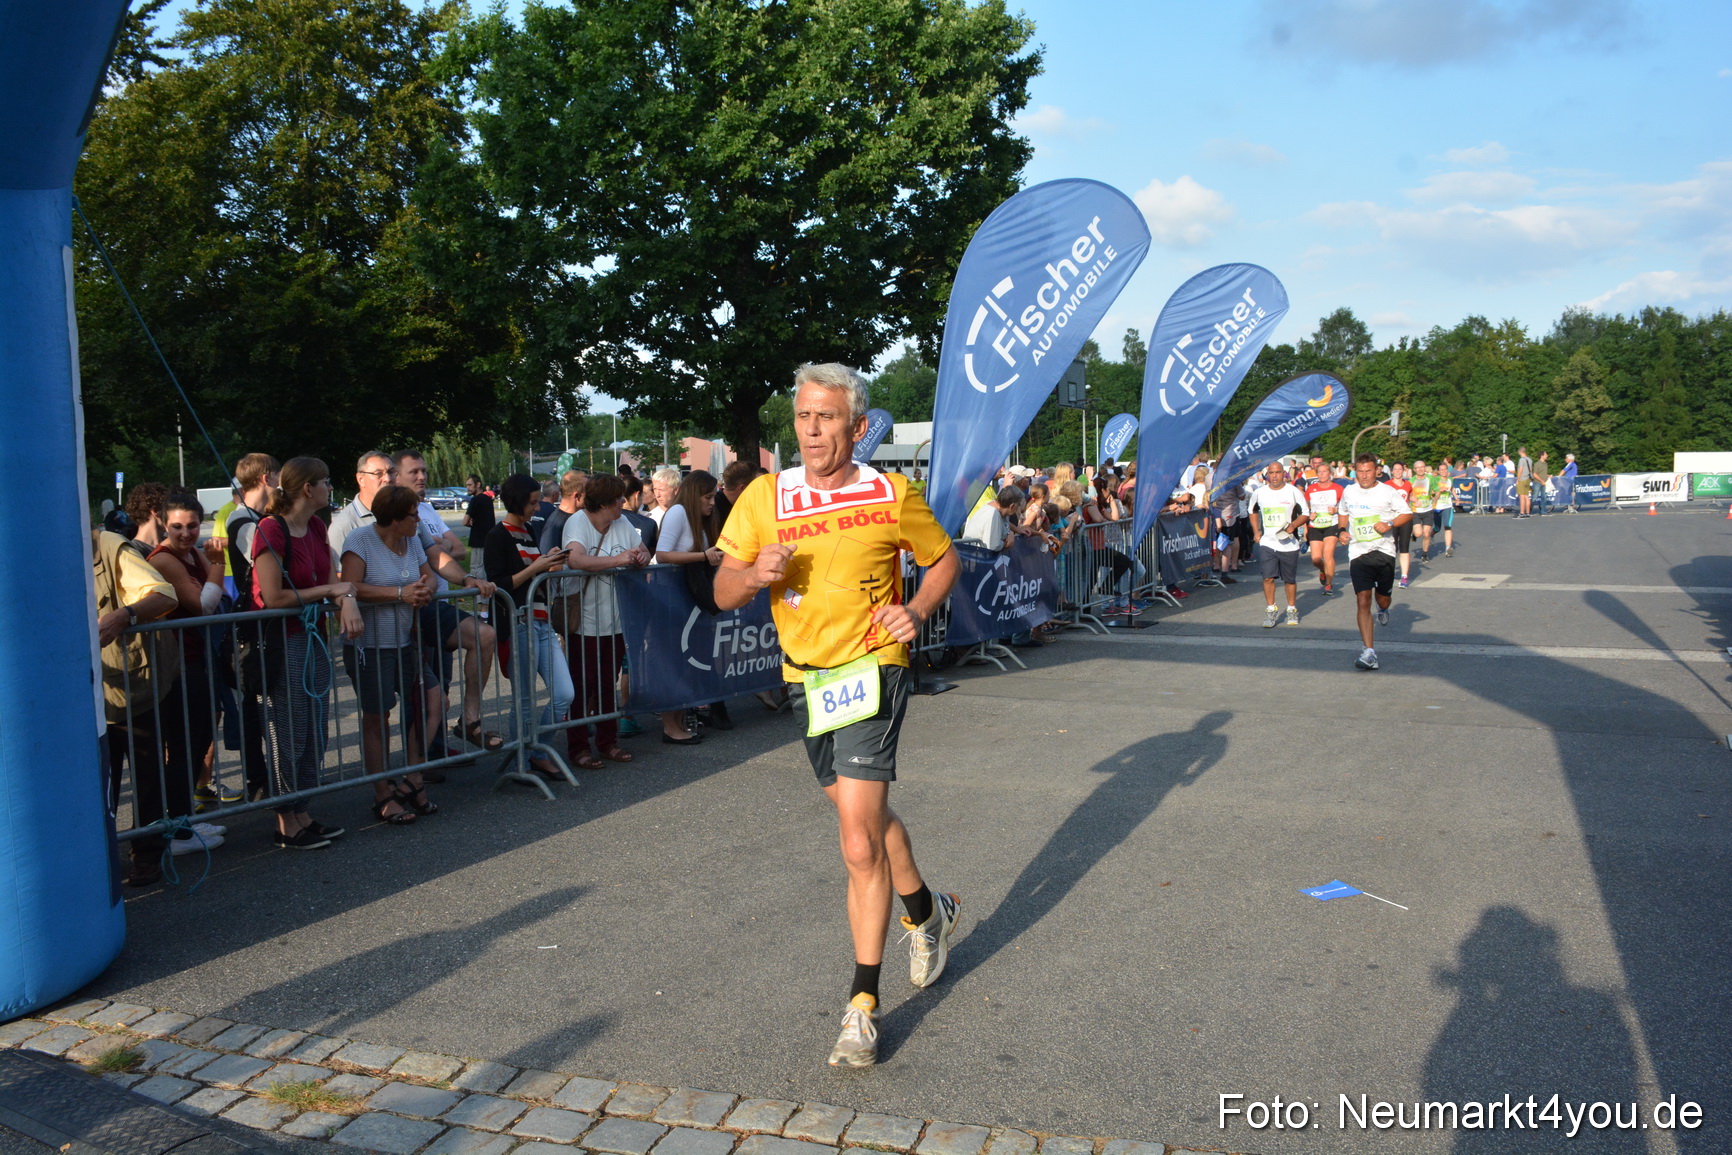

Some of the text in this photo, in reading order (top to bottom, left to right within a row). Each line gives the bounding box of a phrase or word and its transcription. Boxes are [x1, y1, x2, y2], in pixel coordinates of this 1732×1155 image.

[991, 215, 1105, 368] Fischer
[1031, 244, 1118, 367] AUTOMOBILE
[1178, 287, 1257, 398] Fischer
[1206, 307, 1266, 395] AUTOMOBILE
[857, 416, 884, 452] Fischer
[1109, 419, 1131, 450] Fischer
[1232, 408, 1317, 460] Frischmann
[1286, 424, 1307, 439] Druck
[1319, 403, 1345, 421] Medien
[1697, 476, 1721, 489] AOK
[776, 509, 898, 544] MAX BÖGL
[1267, 514, 1281, 522] 411
[1162, 532, 1200, 555] Frischmann
[712, 618, 781, 658] Fisc
[822, 679, 867, 714] 844
